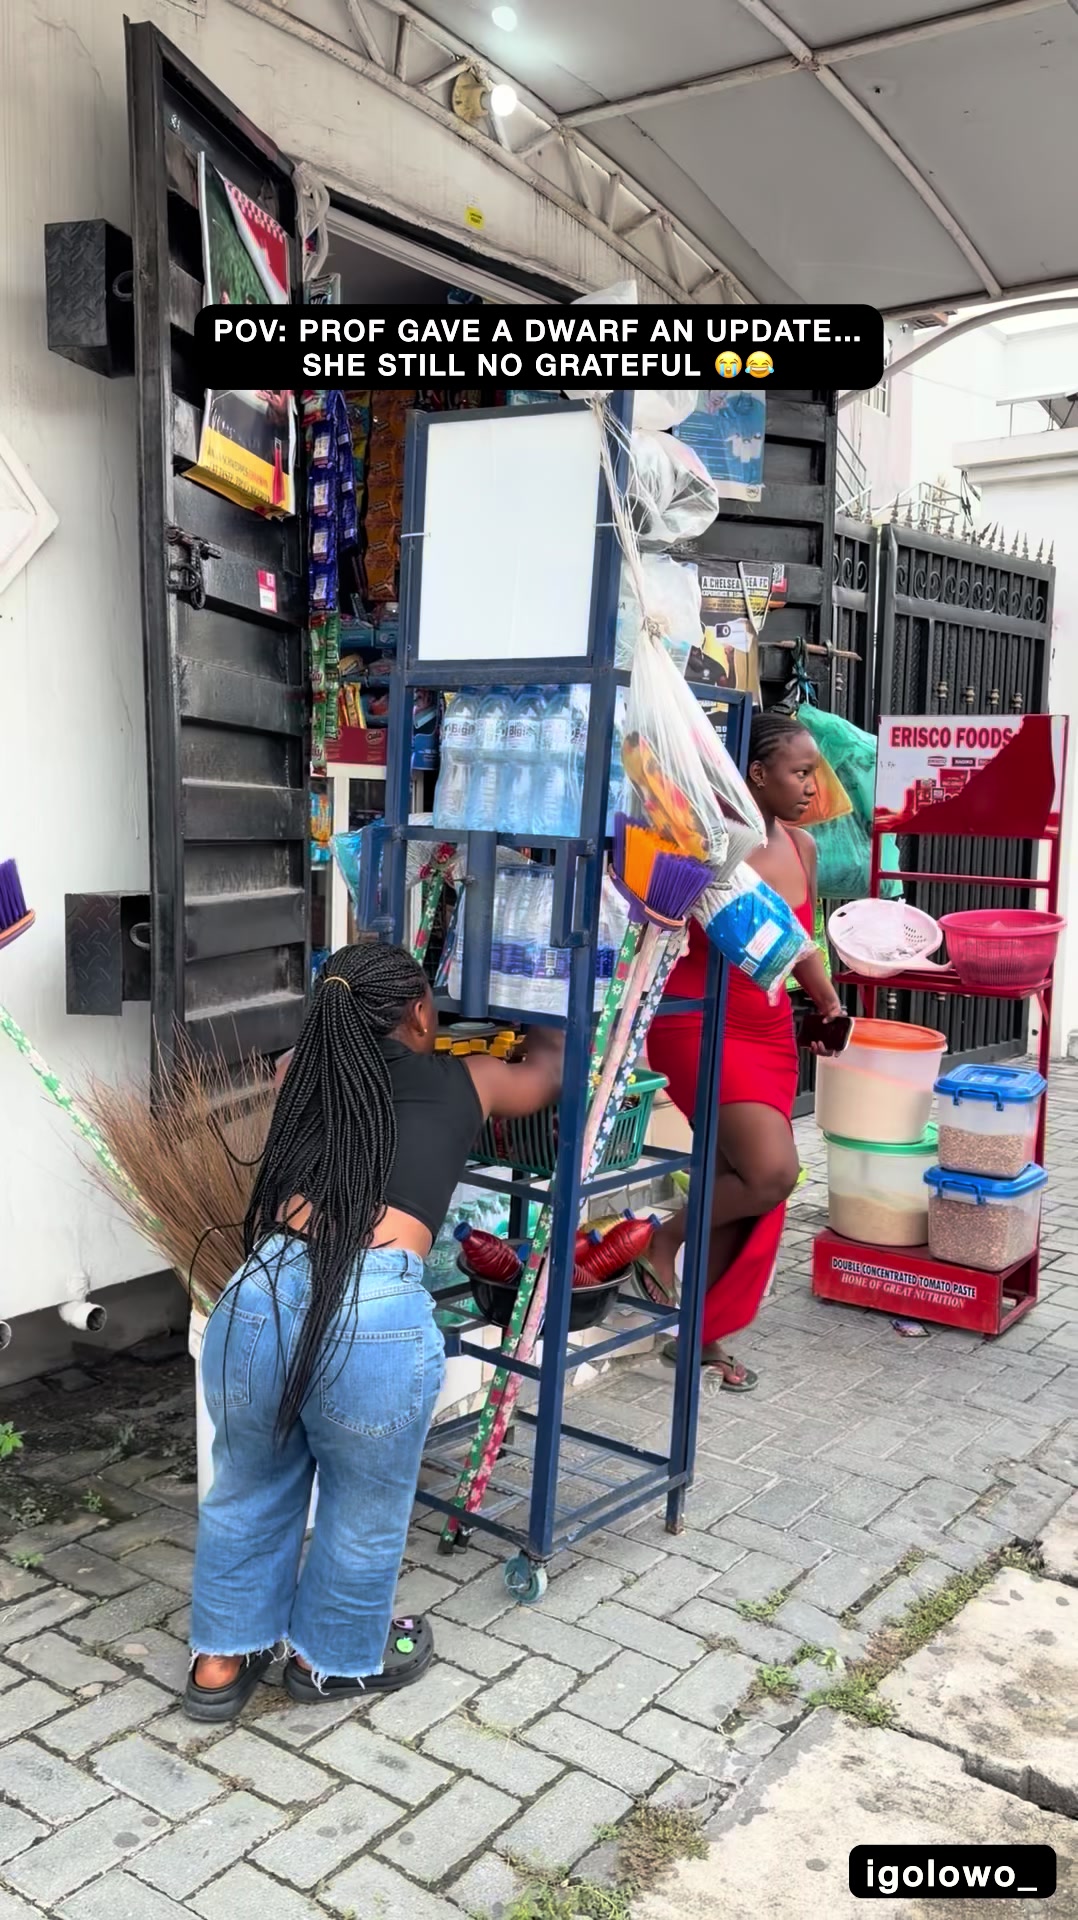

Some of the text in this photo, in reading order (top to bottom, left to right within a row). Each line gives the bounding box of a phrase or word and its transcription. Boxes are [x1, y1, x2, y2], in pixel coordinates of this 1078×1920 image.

[702, 577, 741, 589] A CHELSEA
[760, 577, 769, 588] FC
[891, 726, 1014, 749] ERISCO FOODS
[832, 1257, 976, 1298] DOUBLE CONCENTRATED TOMATO PASTE
[841, 1273, 966, 1309] HOME OF GREAT NUTRITION
